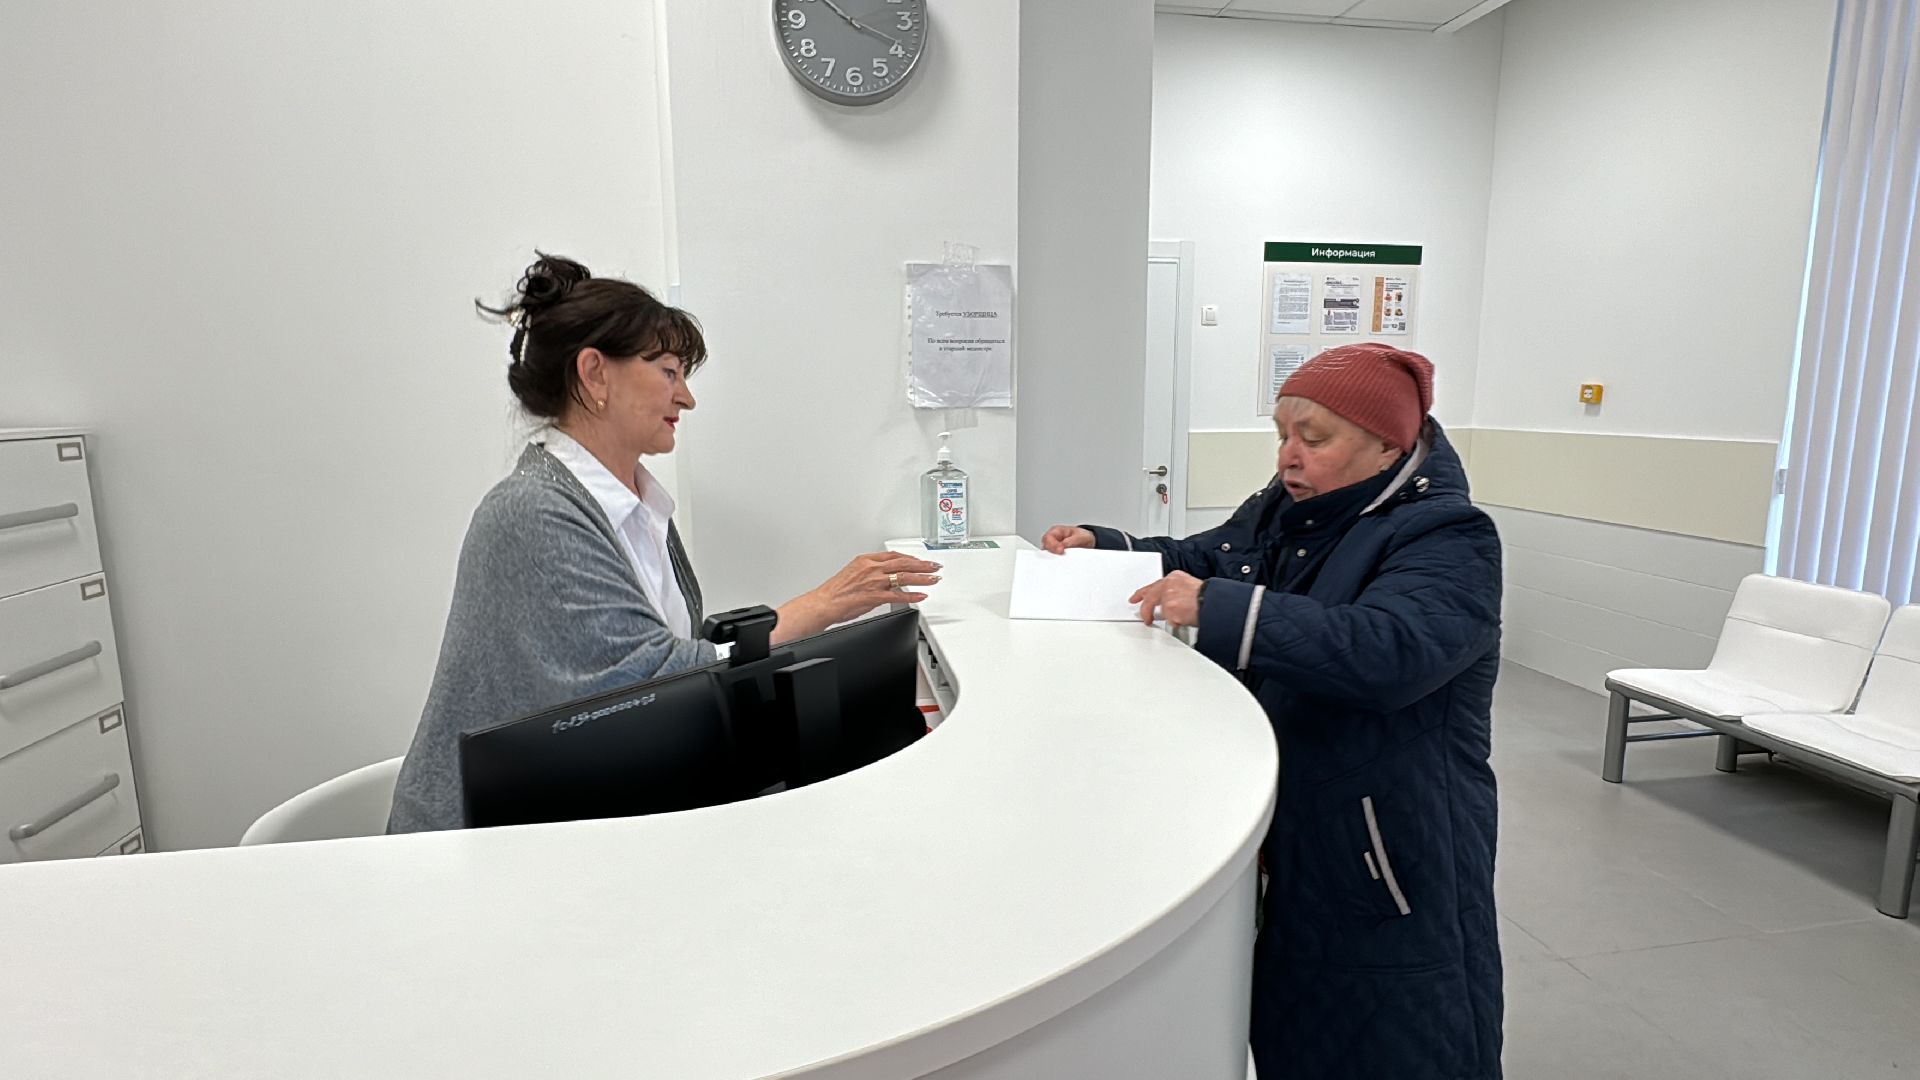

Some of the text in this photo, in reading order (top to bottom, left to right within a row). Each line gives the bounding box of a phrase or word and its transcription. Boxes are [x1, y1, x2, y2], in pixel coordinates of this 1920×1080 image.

[788, 9, 806, 29] 9
[896, 12, 913, 31] 3
[800, 39, 817, 58] 8
[889, 41, 905, 58] 4
[821, 58, 836, 77] 7
[845, 67, 863, 86] 6
[872, 58, 889, 77] 5
[1311, 247, 1376, 259] Информация
